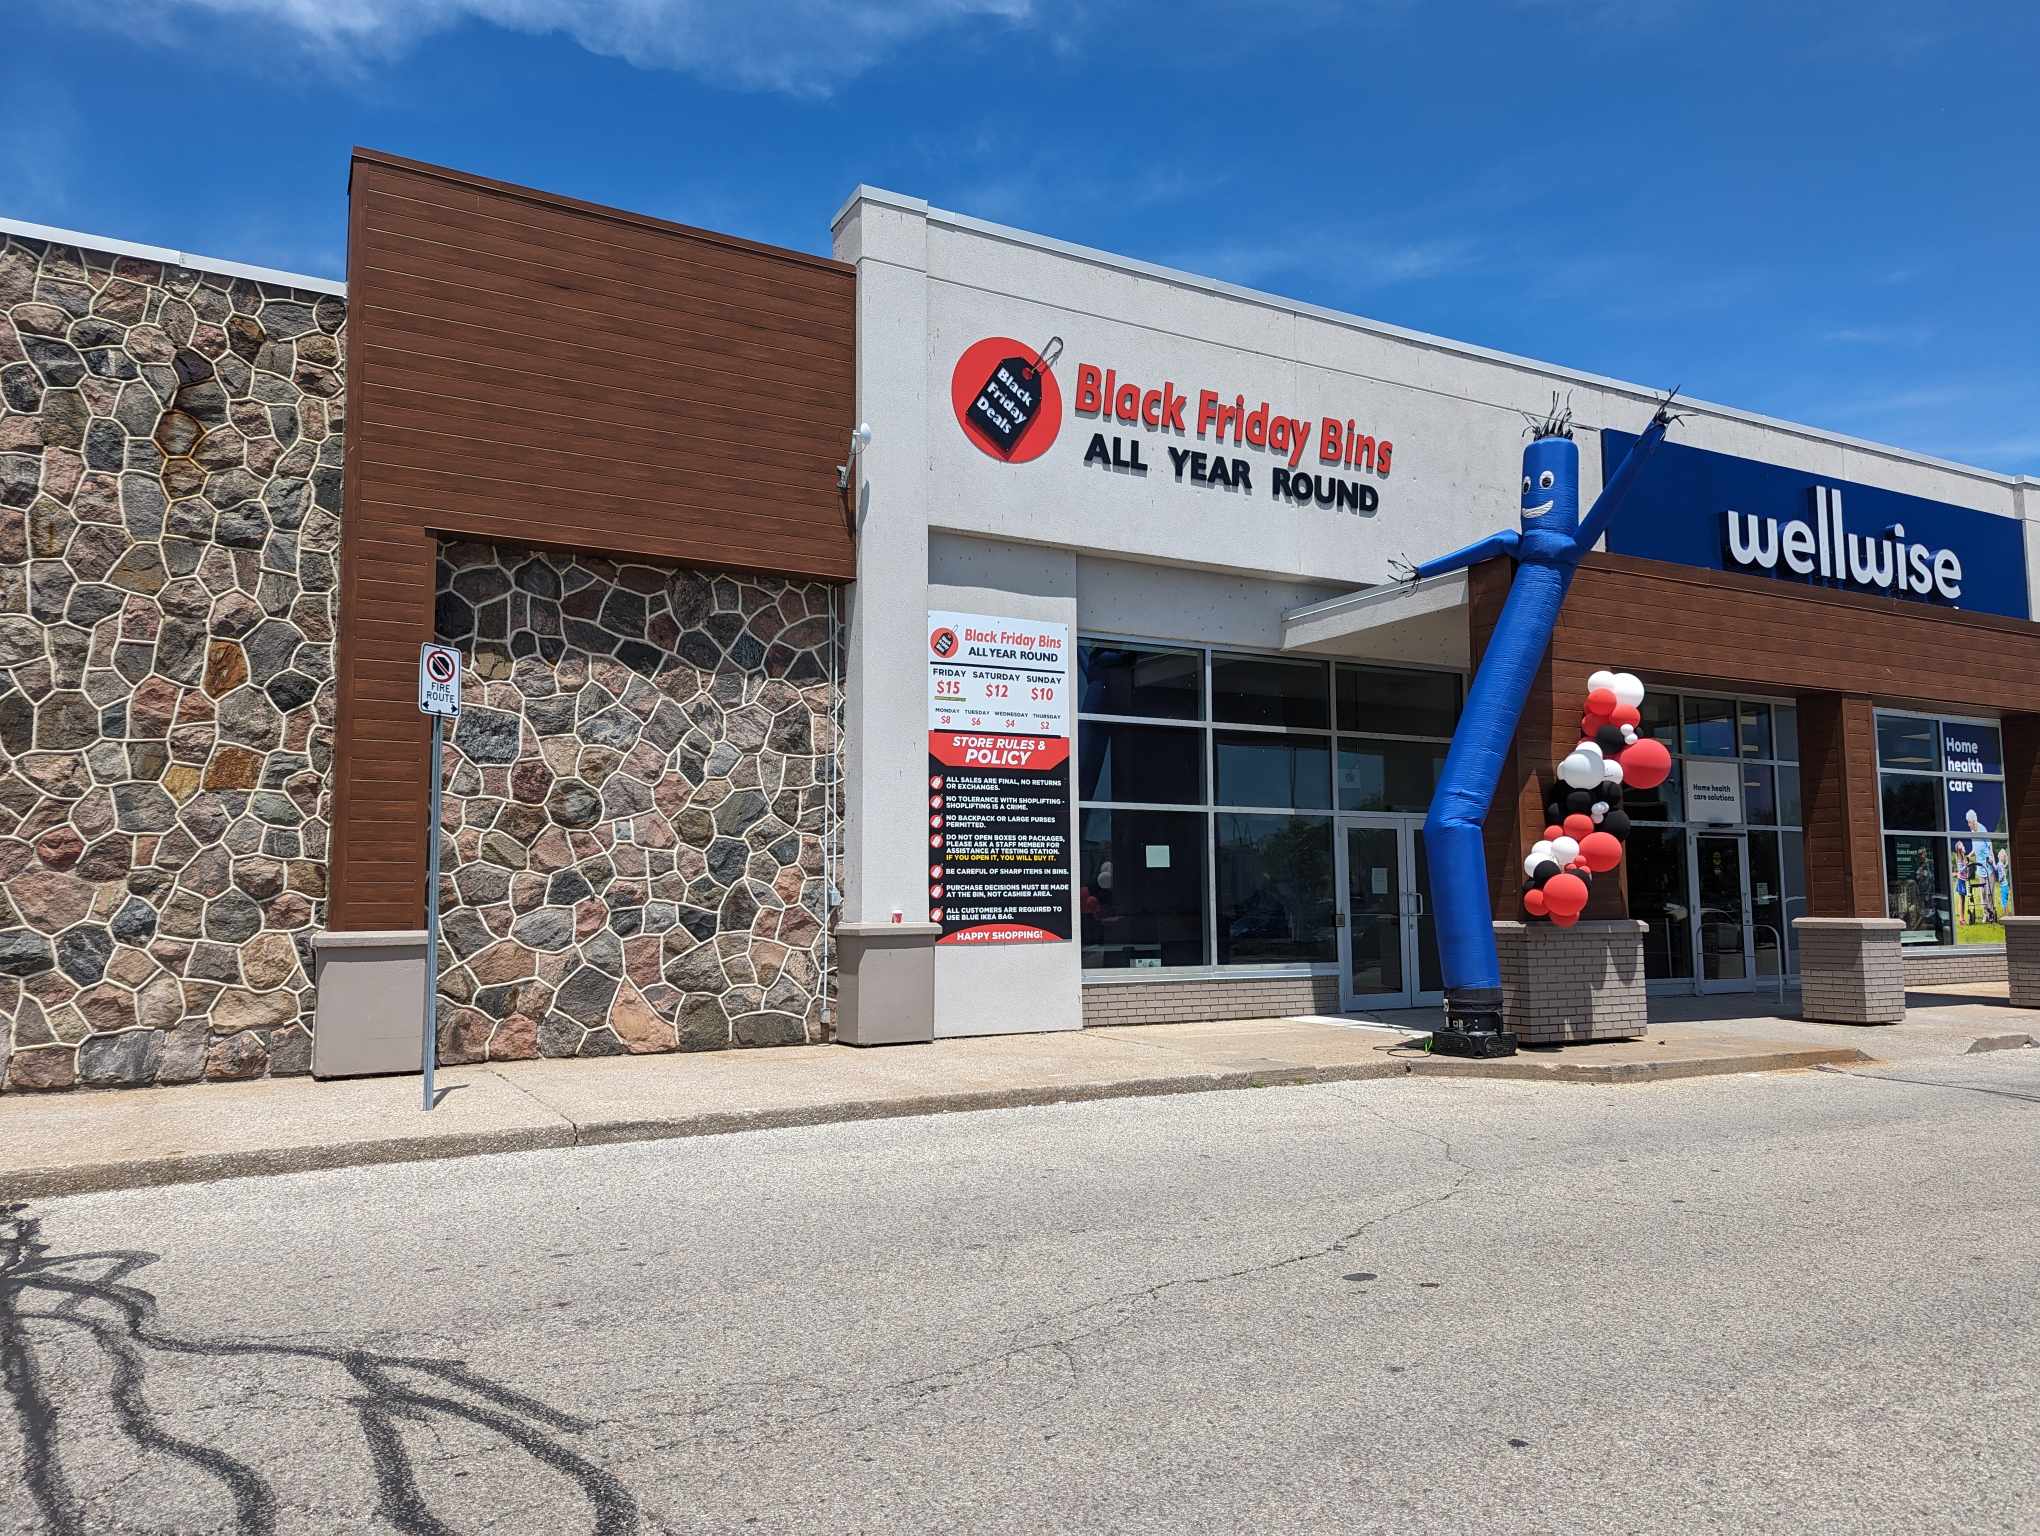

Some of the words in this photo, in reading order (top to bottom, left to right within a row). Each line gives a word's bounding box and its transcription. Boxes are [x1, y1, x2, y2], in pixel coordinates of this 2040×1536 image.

[997, 368, 1032, 407] Black
[987, 382, 1027, 424] Friday
[977, 396, 1011, 434] Deals
[1075, 363, 1187, 431] Black
[1197, 389, 1311, 466] Friday
[1319, 416, 1393, 474] Bins
[1084, 433, 1148, 472] ALL
[1168, 446, 1252, 489] YEAR
[1272, 468, 1379, 513] ROUND
[1728, 485, 1962, 598] wellwise
[965, 629, 997, 643] Black
[1001, 632, 1036, 650] Friday
[1039, 635, 1062, 648] Bins
[968, 647, 988, 656] ALL
[988, 649, 1016, 659] YEAR
[1020, 652, 1058, 662] ROUND
[933, 668, 966, 677] FRIDAY
[973, 671, 1020, 681] SATURDAY
[1027, 675, 1061, 684] SUNDAY
[432, 682, 450, 693] FIRE
[937, 680, 960, 694] $15
[985, 683, 1008, 698] $12
[1031, 687, 1053, 700] $10
[427, 691, 455, 703] ROUTE
[971, 717, 981, 726] $6
[1005, 719, 1015, 728] $4
[1040, 721, 1049, 730] $2
[952, 736, 994, 747] STORE
[996, 739, 1035, 749] RULES
[1038, 740, 1046, 750] &
[1946, 737, 1978, 754] Home
[965, 749, 1031, 765] POLICY
[1948, 756, 1983, 774] health
[1712, 784, 1730, 792] health
[1949, 780, 1973, 792] care
[957, 932, 990, 940] HAPPY
[992, 930, 1042, 939] SHOPPING!
